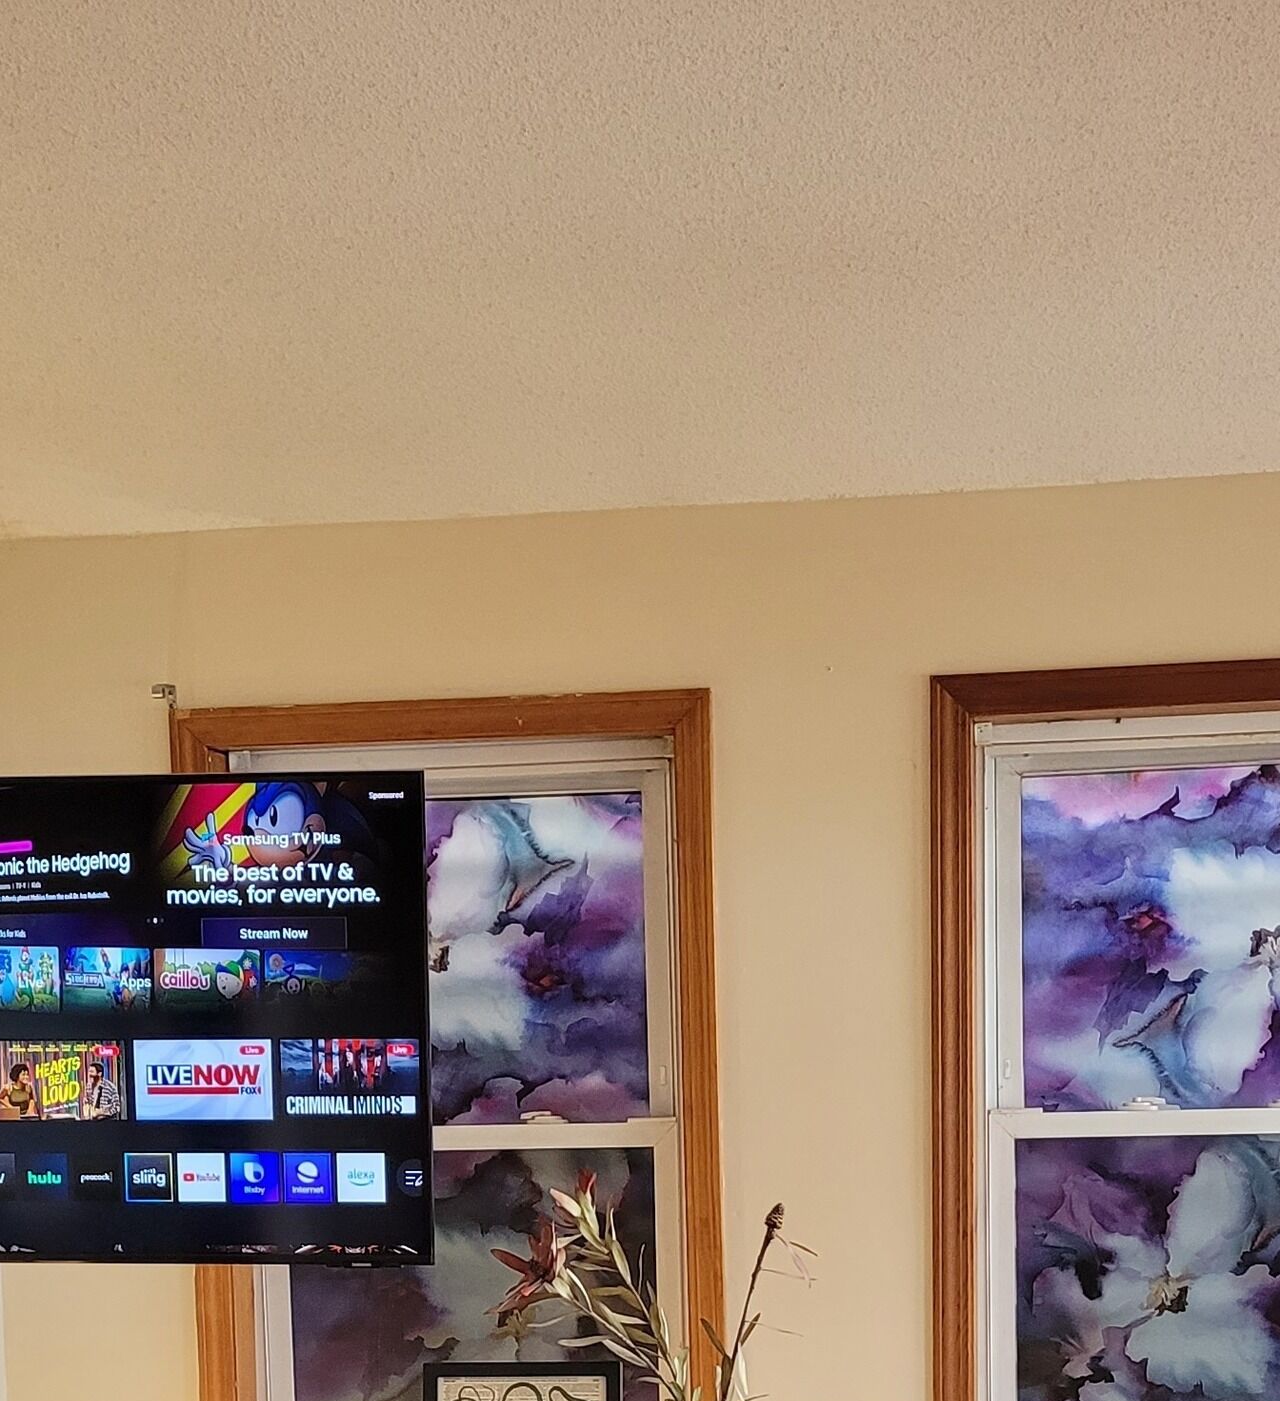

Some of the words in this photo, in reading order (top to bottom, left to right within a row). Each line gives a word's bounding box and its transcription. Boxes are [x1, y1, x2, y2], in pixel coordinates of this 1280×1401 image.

[223, 833, 289, 848] Samsung
[292, 832, 310, 845] TV
[313, 831, 341, 845] Plus
[26, 855, 49, 875] the
[51, 851, 131, 877] Hedgehog
[191, 864, 229, 882] The
[233, 863, 278, 882] best
[282, 862, 304, 881] of
[308, 863, 334, 881] TV
[337, 863, 354, 881] &
[166, 885, 243, 907] movies,
[246, 885, 276, 904] for
[280, 886, 381, 908] everyone.
[14, 929, 26, 938] Kids
[239, 928, 280, 940] Stream
[282, 928, 308, 940] Now
[120, 977, 152, 990] Apps
[35, 1056, 81, 1079] HEARTS
[48, 1072, 69, 1087] BEAT
[42, 1080, 80, 1106] LOUD
[240, 1087, 257, 1095] FOX
[286, 1096, 352, 1115] CRIMINAL
[353, 1096, 402, 1115] MINDS
[27, 1171, 62, 1184] hulu
[80, 1172, 111, 1183] peacock
[132, 1168, 166, 1187] sling
[347, 1168, 375, 1179] alexa
[292, 1186, 324, 1194] Internet
